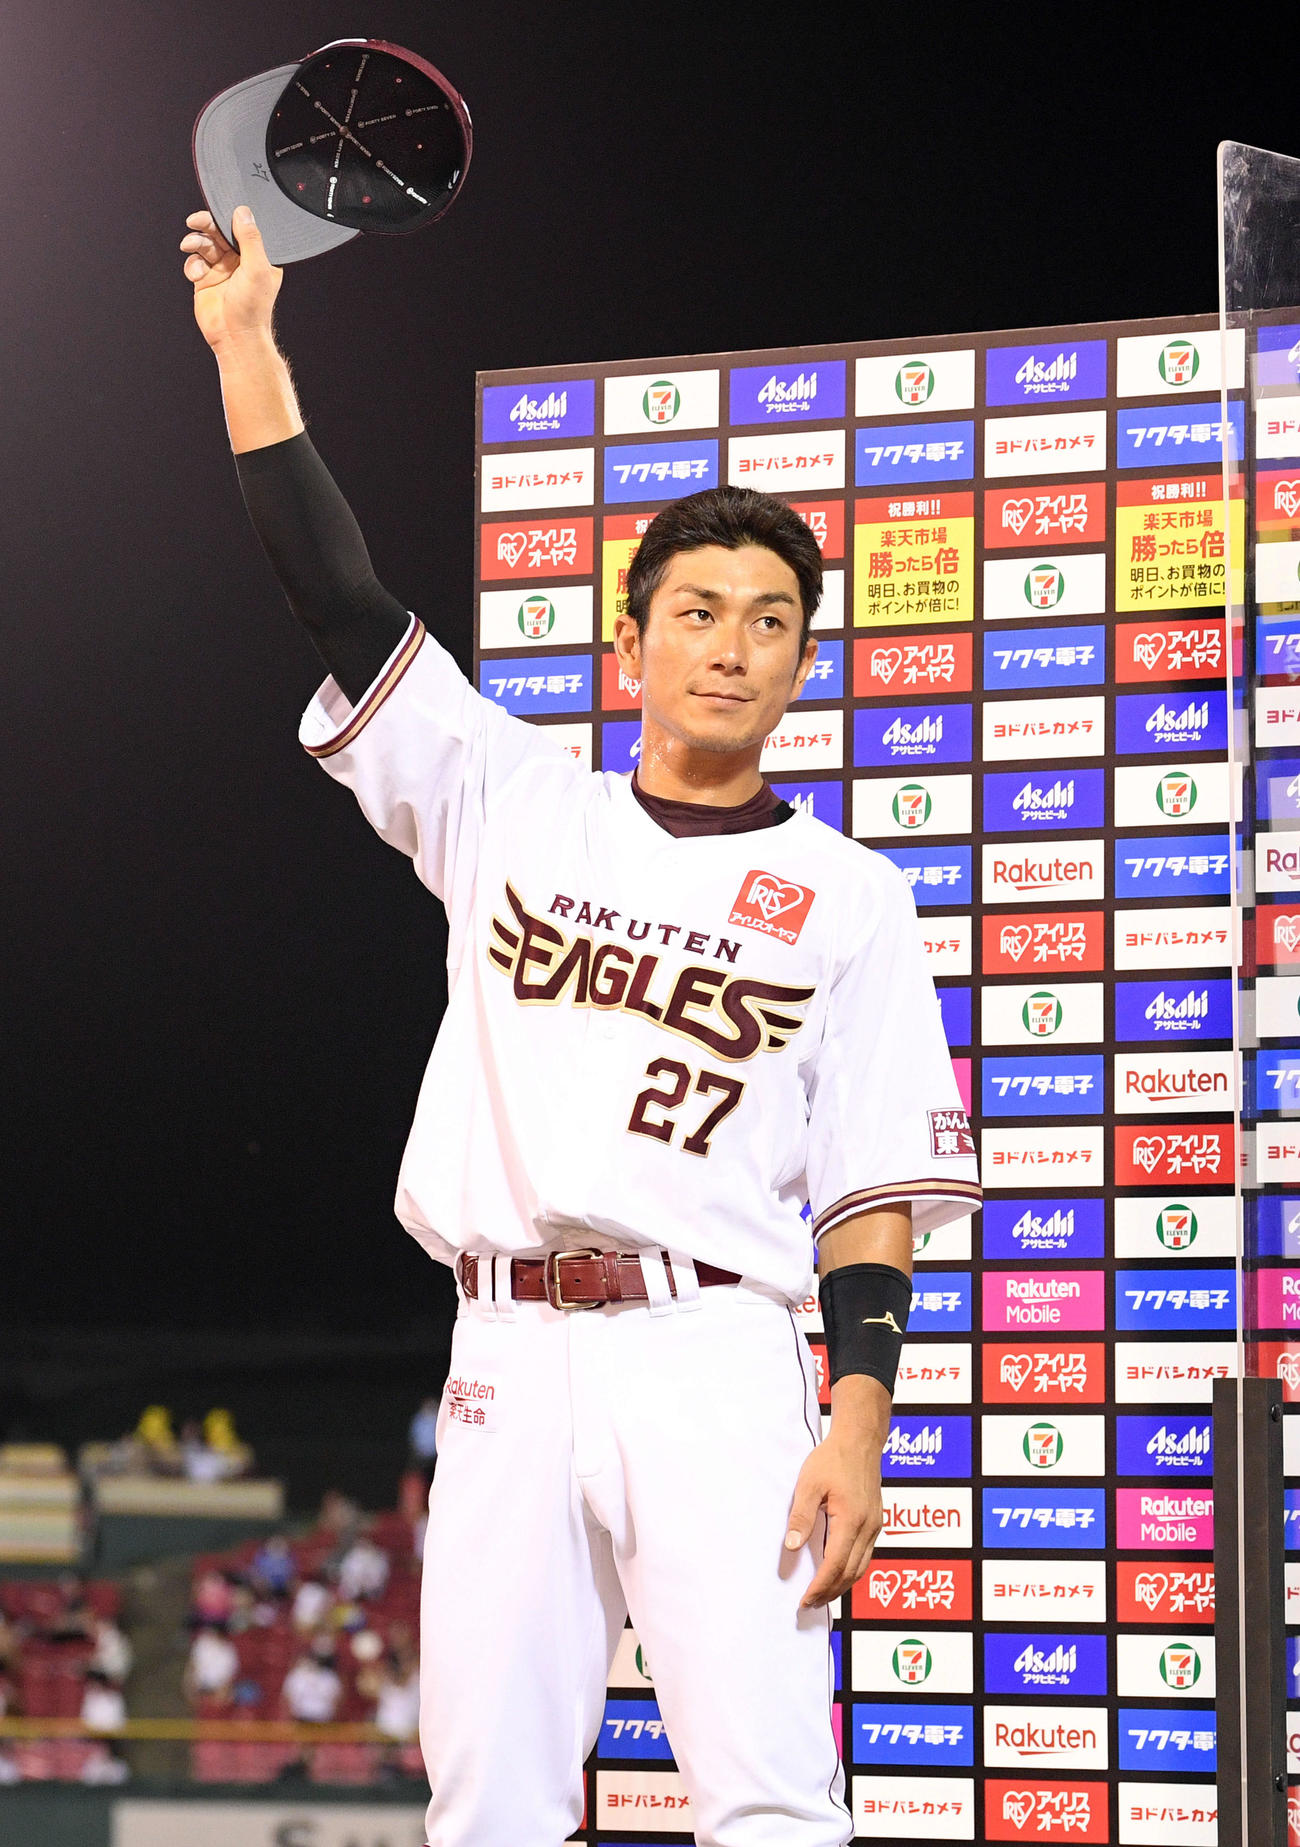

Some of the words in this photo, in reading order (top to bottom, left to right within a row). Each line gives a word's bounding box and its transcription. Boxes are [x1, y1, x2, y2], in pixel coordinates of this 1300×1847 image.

[1015, 352, 1077, 384] Asahi
[1169, 352, 1190, 381] 7
[758, 372, 817, 403] Asahi
[905, 372, 925, 401] 7
[1024, 382, 1069, 394] アサヒビール
[510, 392, 567, 421] Asahi
[653, 391, 671, 420] 7
[766, 401, 810, 413] アサヒビール
[518, 420, 560, 431] アサヒビール
[996, 435, 1094, 454] ヨドバシカメラ
[740, 454, 834, 472] ヨドバシカメラ
[492, 472, 583, 489] ヨドバシカメラ
[1152, 482, 1206, 500] 祝勝利!!
[888, 500, 940, 517] 祝勝利!!
[1036, 495, 1087, 515] アイリス
[1036, 514, 1087, 535] オーヤマ
[1144, 510, 1212, 530] 楽天市場
[528, 528, 576, 548] アイリス
[881, 527, 947, 547] 楽天市場
[1131, 530, 1224, 562] 勝ったら倍
[528, 548, 576, 567] オーヤマ
[869, 547, 959, 578] 勝ったら倍
[1131, 564, 1225, 582] 明日、お買物の
[869, 580, 959, 598] 明日、お買物の
[1035, 576, 1055, 605] 7
[1131, 582, 1225, 599] ポイントが倍に!
[869, 598, 958, 615] ポイントが倍に!
[528, 606, 546, 635] 7
[1168, 629, 1221, 650] アイリス
[904, 645, 955, 664] アイリス
[1168, 649, 1221, 670] オーヤマ
[904, 664, 954, 684] オーヤマ
[1146, 702, 1208, 732] Asahi
[882, 715, 942, 745] Asahi
[995, 721, 1092, 737] ヨドバシカメラ
[1154, 731, 1201, 743] アサヒビール
[765, 733, 833, 749] バシカメラ
[891, 744, 936, 755] アサヒビール
[1013, 780, 1074, 810] Asahi
[1167, 783, 1187, 813] 7
[903, 795, 922, 824] 7
[1021, 810, 1067, 820] アサヒビール
[994, 859, 1092, 883] Rakuten
[547, 893, 743, 963] RAKUTEN
[728, 911, 799, 943] アイリスオーヤマ
[1034, 923, 1086, 942] アイリス
[1126, 931, 1227, 946] ヨドバシカメラ
[1034, 943, 1086, 962] オーヤマ
[487, 876, 817, 1063] EAGLES
[1145, 990, 1208, 1019] Asahi
[1033, 1003, 1053, 1032] 7
[1154, 1020, 1201, 1030] アサヒビール
[1127, 1069, 1227, 1093] Rakuten
[626, 1056, 748, 1158] 27
[1167, 1135, 1220, 1154] アイリス
[994, 1151, 1092, 1164] ヨドバシカメラ
[1168, 1155, 1220, 1174] オーヤマ
[1012, 1209, 1074, 1238] Asahi
[1167, 1216, 1187, 1245] 7
[1021, 1239, 1067, 1248] アサヒビール
[1006, 1279, 1080, 1298] Rakuten
[1007, 1305, 1060, 1323] Mobile
[1034, 1354, 1086, 1373] アイリス
[1127, 1366, 1229, 1379] ヨドバシカメラ
[445, 1376, 496, 1401] Rakuten
[1034, 1374, 1086, 1392] オーヤマ
[882, 1426, 943, 1455] Asahi
[1033, 1434, 1054, 1464] 7
[1147, 1426, 1210, 1454] Asahi
[890, 1455, 935, 1465] アサヒビール
[1156, 1456, 1203, 1466] アサヒビール
[882, 1503, 960, 1528] akuten
[1141, 1523, 1196, 1541] Mobile
[902, 1570, 954, 1589] アイリス
[903, 1590, 954, 1609] オーヤマ
[995, 1584, 1093, 1597] ヨドバシカメラ
[903, 1650, 922, 1680] 7
[1014, 1644, 1076, 1673] Asahi
[1023, 1674, 1070, 1684] アサヒビール
[1170, 1655, 1190, 1685] 7
[996, 1723, 1096, 1748] Rakuten
[608, 1794, 688, 1808] ヨドバシカメ
[864, 1800, 962, 1814] ヨドバシカメラ
[1037, 1791, 1090, 1812] アイリス
[1037, 1811, 1090, 1832] オーヤマ
[1132, 1808, 1219, 1822] ヨドバシカメ
